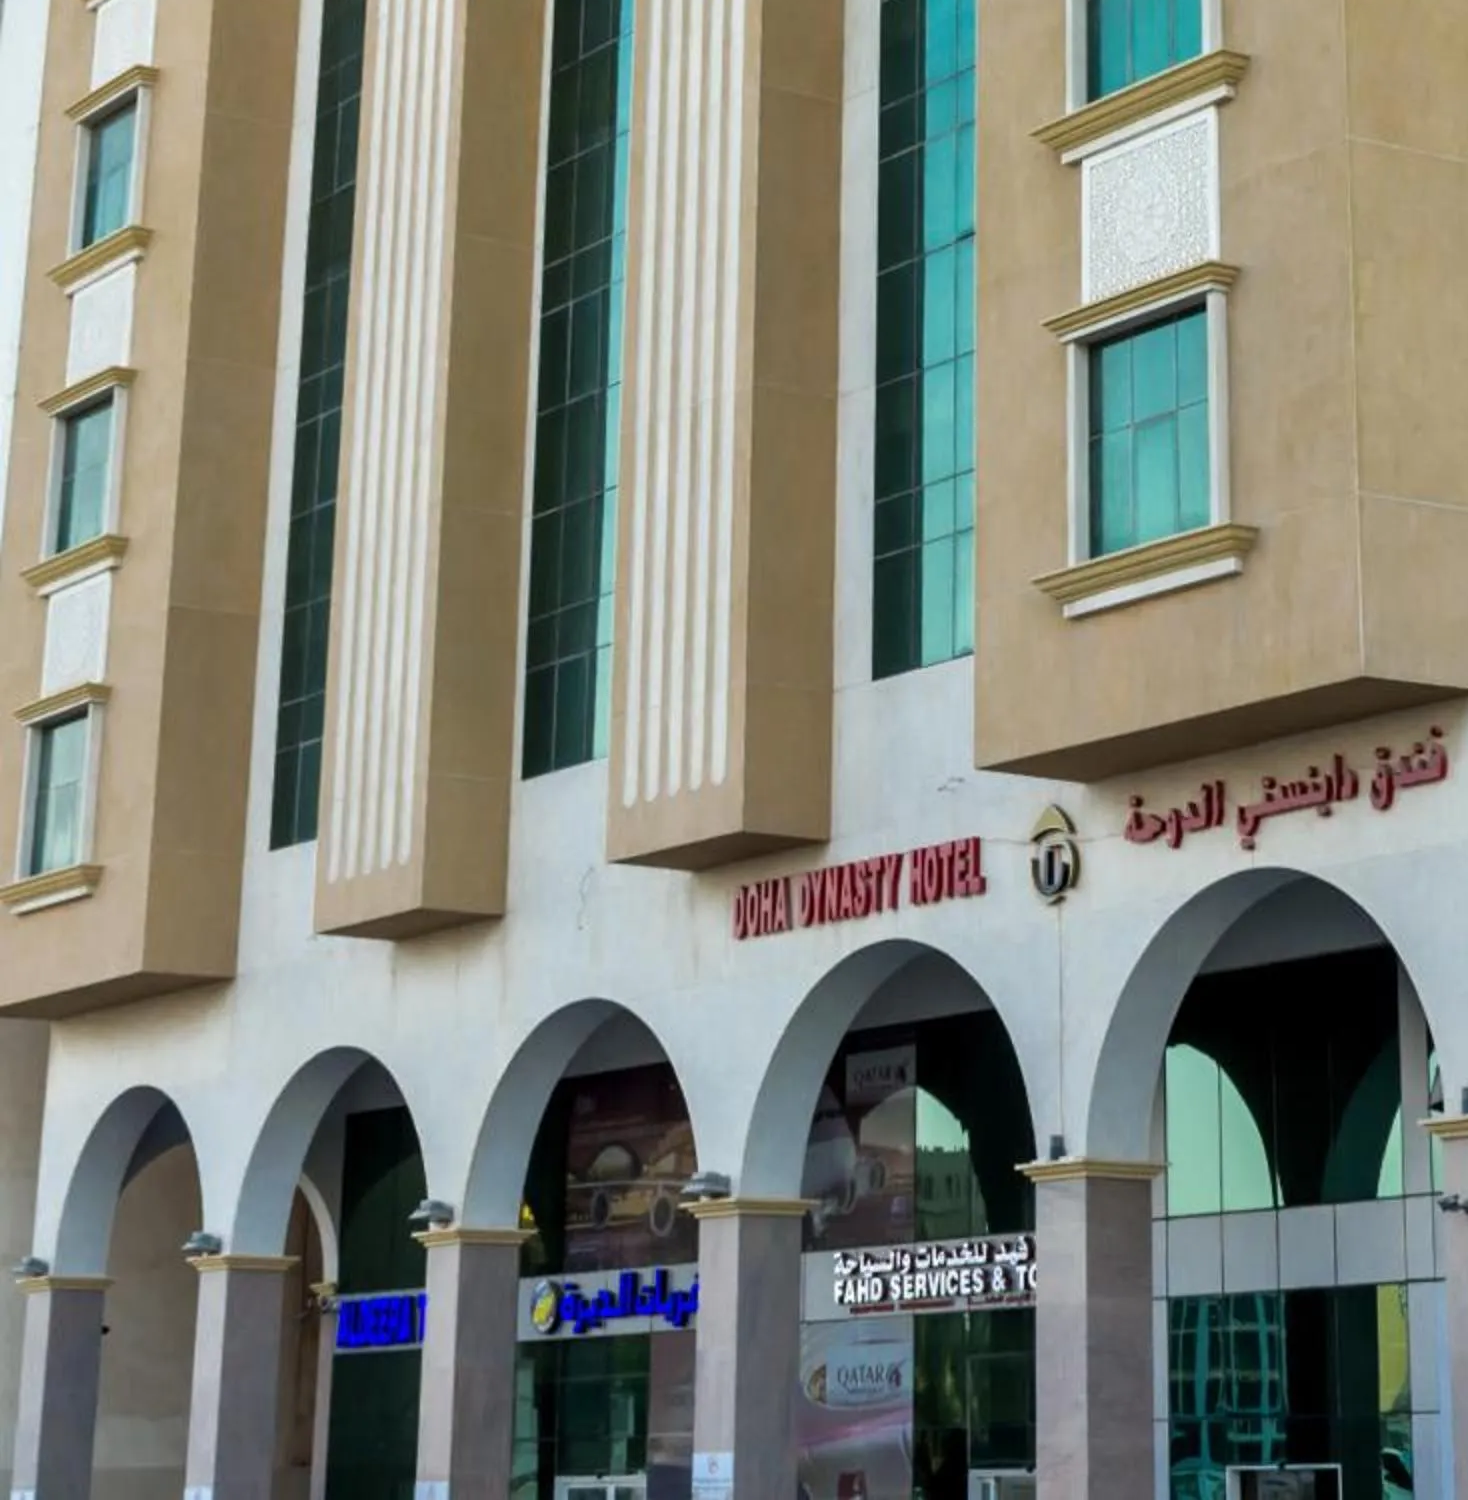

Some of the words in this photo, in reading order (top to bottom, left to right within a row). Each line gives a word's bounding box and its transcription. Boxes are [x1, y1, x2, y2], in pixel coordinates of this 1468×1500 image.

[1370, 725, 1449, 811] فندق
[1125, 780, 1226, 849] الدوحة
[733, 876, 793, 940] DOHA
[800, 853, 904, 929] DYNASTY
[909, 836, 987, 907] HOTEL
[833, 1275, 883, 1304] FAHD
[890, 1268, 984, 1301] SERVICES
[991, 1265, 1006, 1293] &
[837, 1362, 885, 1391] QATAR
